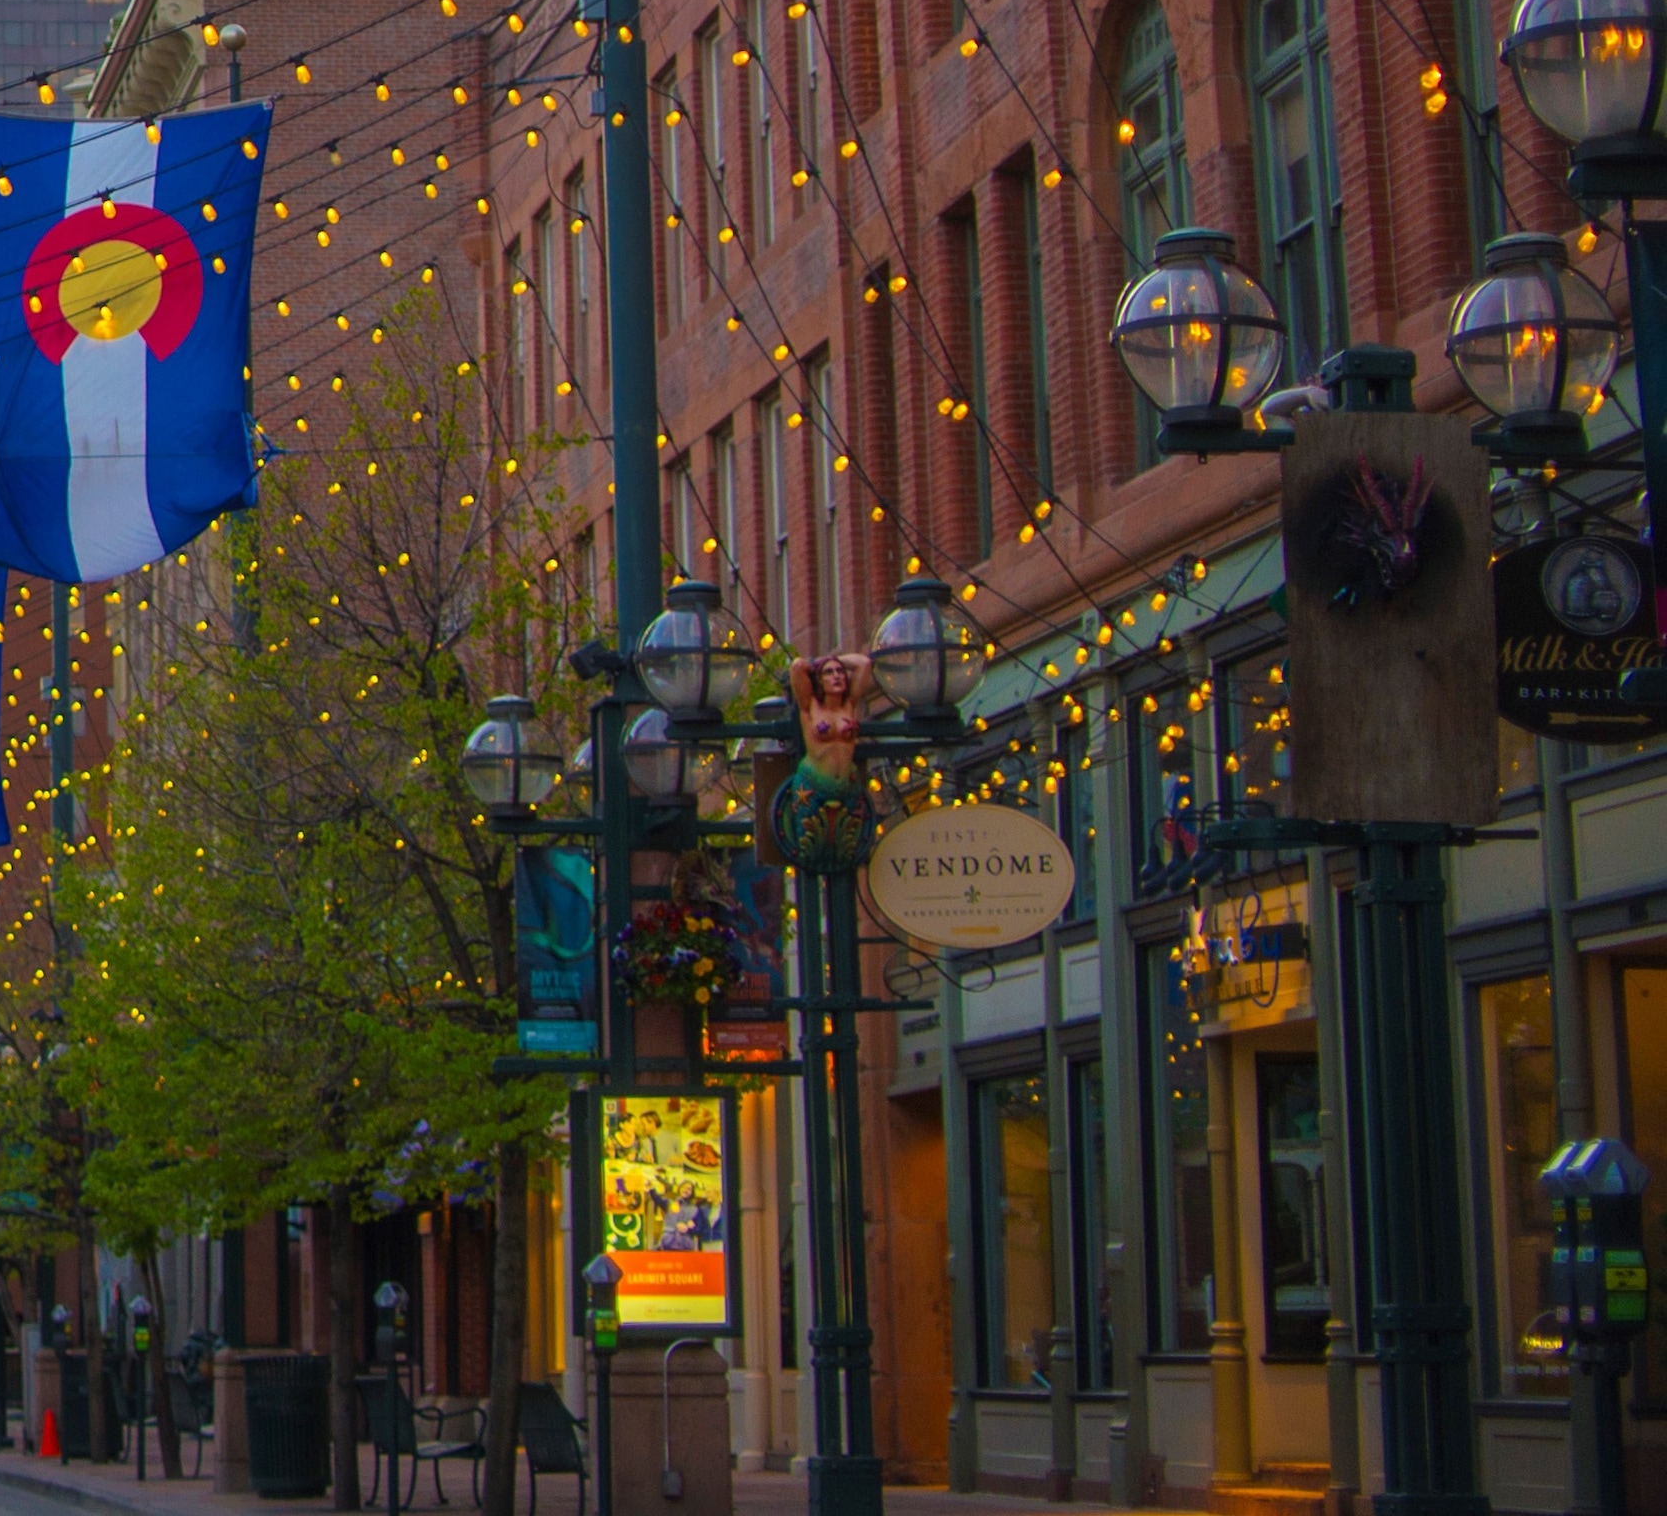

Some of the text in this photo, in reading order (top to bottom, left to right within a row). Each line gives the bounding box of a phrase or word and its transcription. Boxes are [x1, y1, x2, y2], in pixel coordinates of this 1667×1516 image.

[1500, 635, 1568, 672] Milk
[1574, 642, 1613, 671] &
[1519, 687, 1625, 700] BAR KIT
[890, 847, 1054, 877] VENDÔME
[628, 1273, 703, 1285] LARIMER SQUARE
